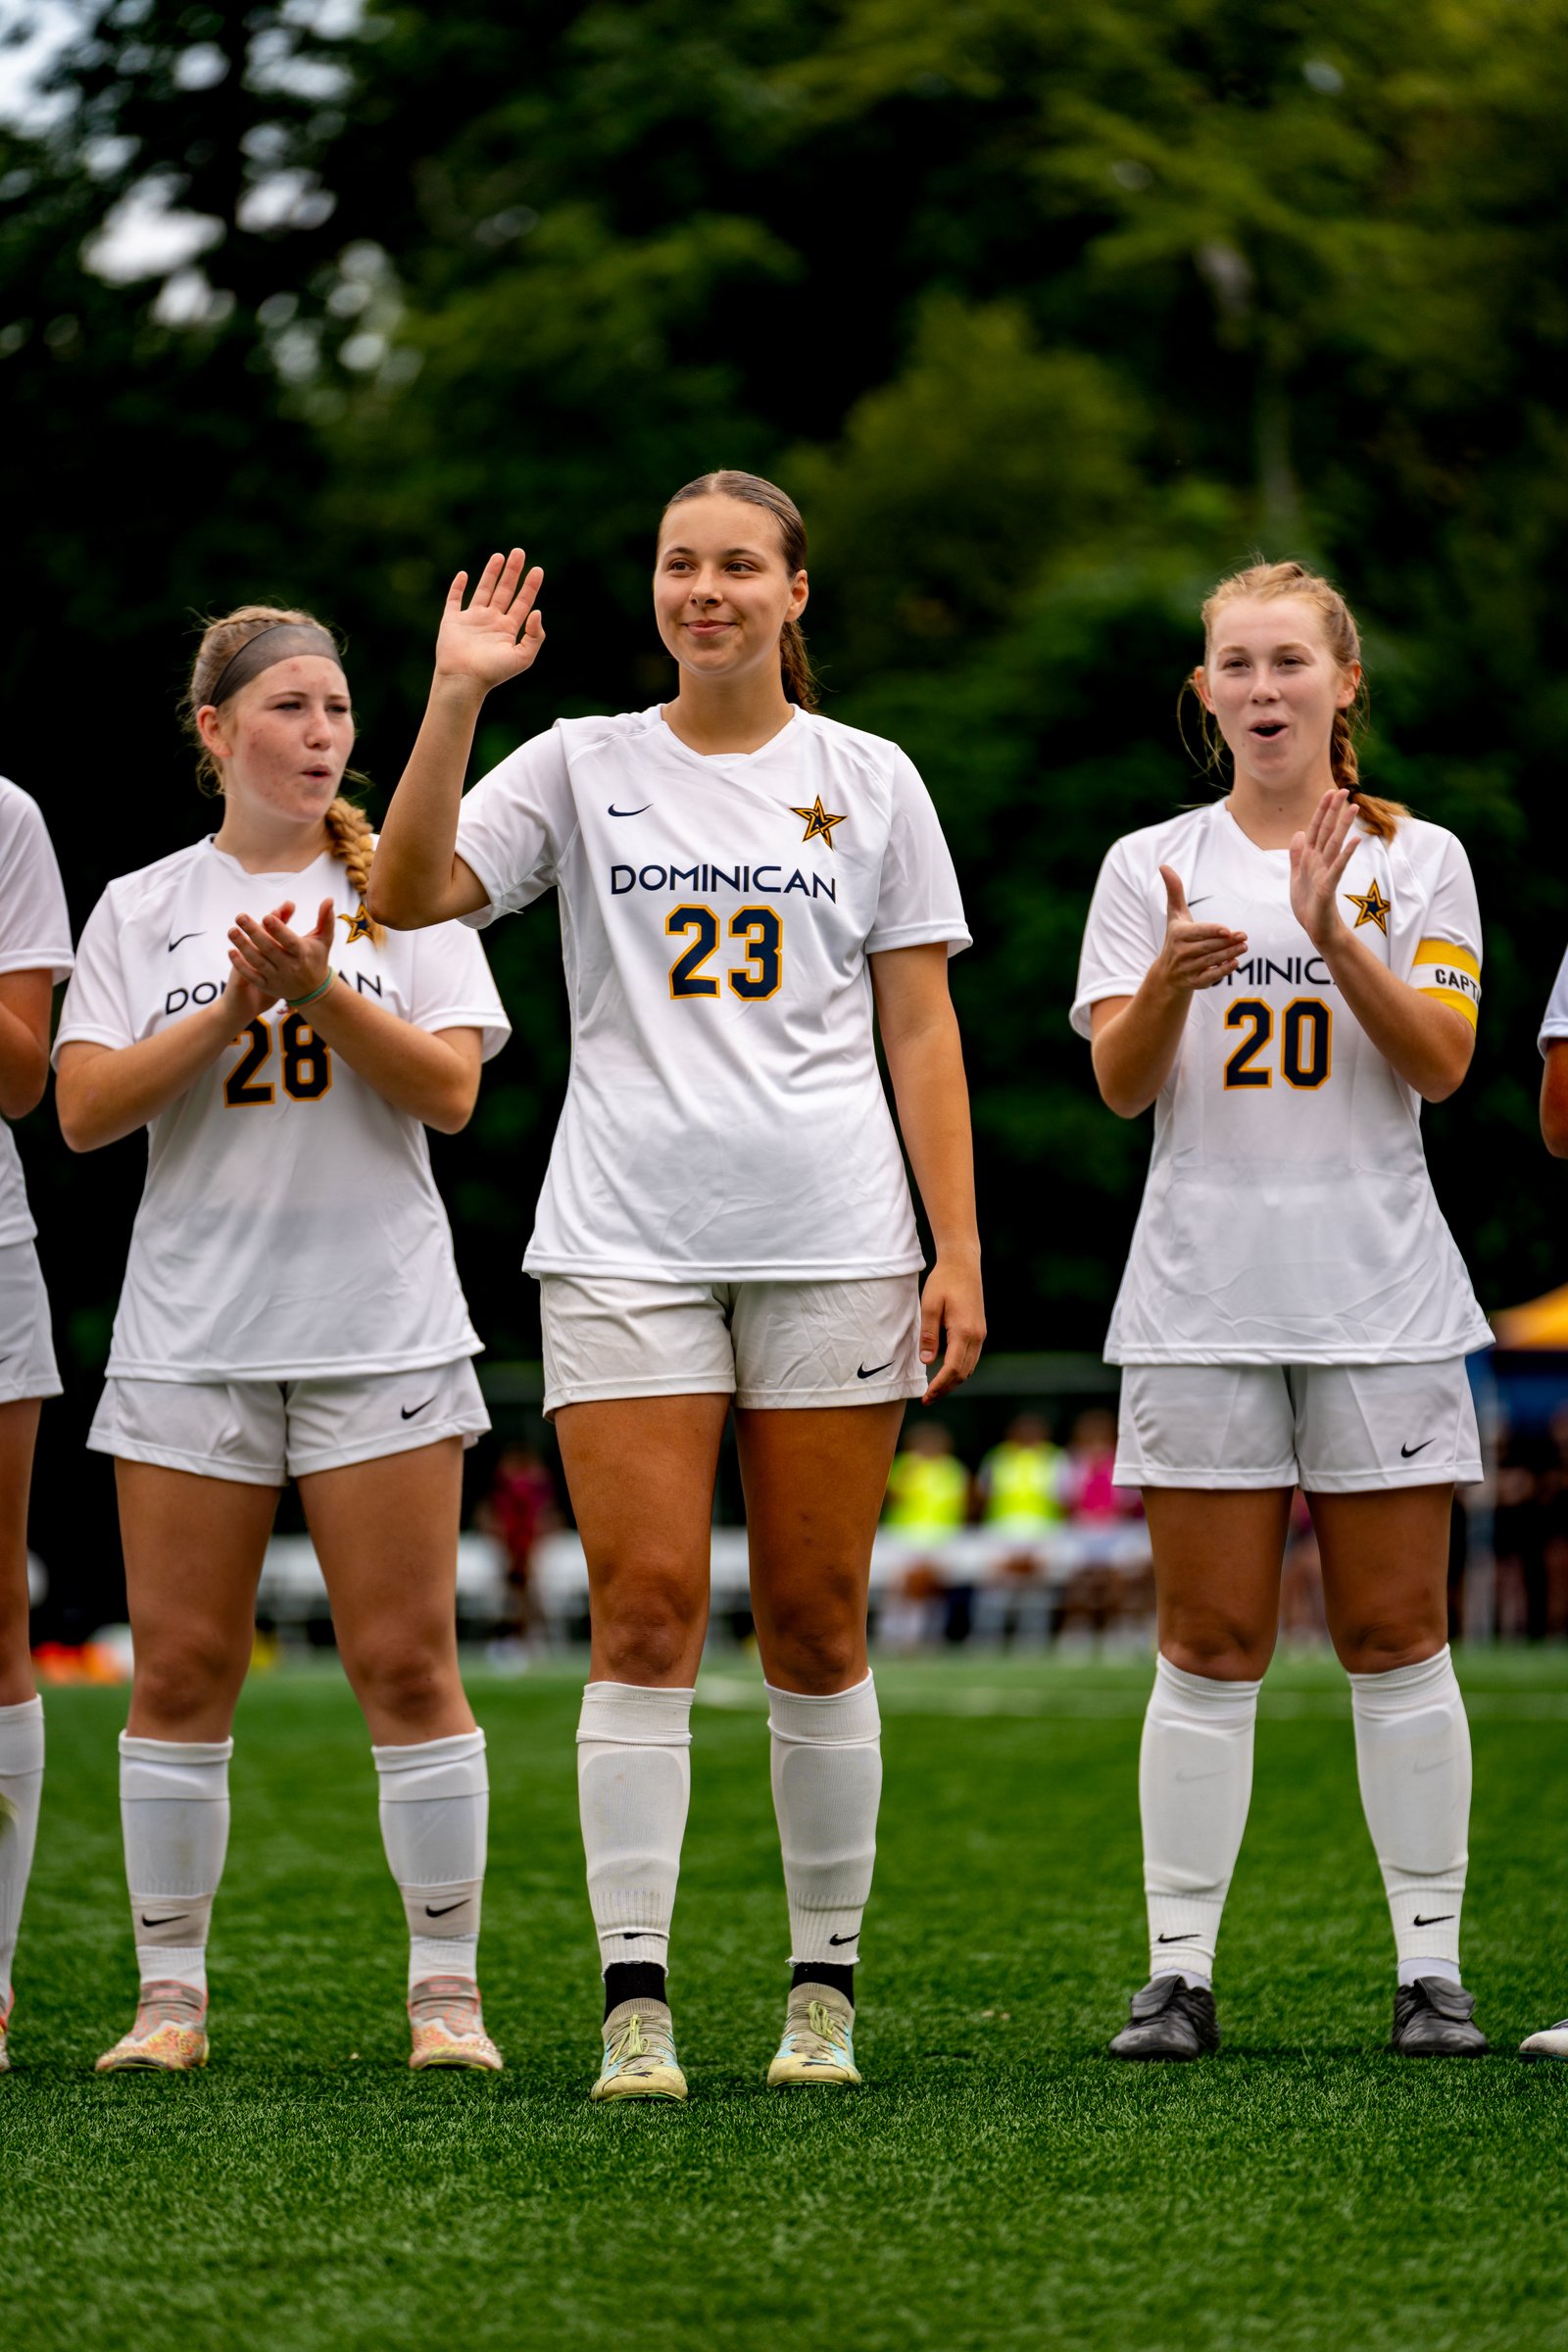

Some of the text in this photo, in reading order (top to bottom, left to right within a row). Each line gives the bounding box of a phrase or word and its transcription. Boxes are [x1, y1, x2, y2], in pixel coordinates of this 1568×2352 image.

[611, 863, 837, 904] DOMINICAN
[664, 903, 783, 1003] 23
[1211, 956, 1337, 987] MINIC
[1435, 968, 1480, 1004] CAPT
[223, 1008, 333, 1108] 28
[1223, 997, 1334, 1091] 20
